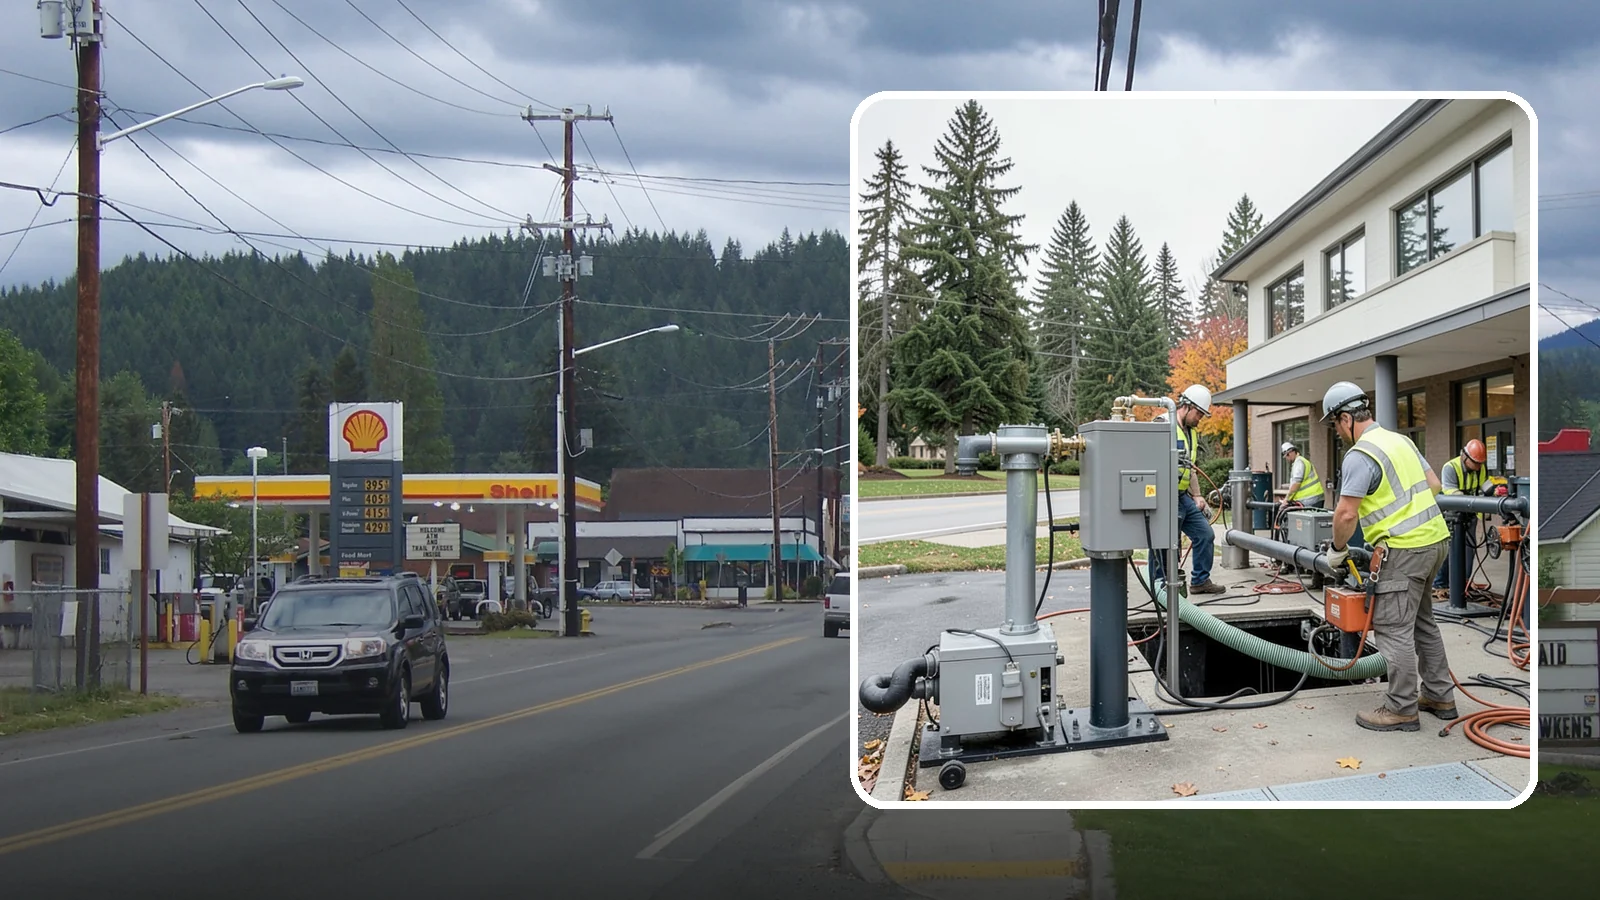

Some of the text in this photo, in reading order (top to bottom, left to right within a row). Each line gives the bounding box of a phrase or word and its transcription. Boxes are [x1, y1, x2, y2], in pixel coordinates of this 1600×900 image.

[365, 480, 383, 490] 395
[490, 484, 547, 499] Shell
[365, 494, 383, 504] 405
[365, 508, 383, 518] 415
[365, 522, 383, 532] 429
